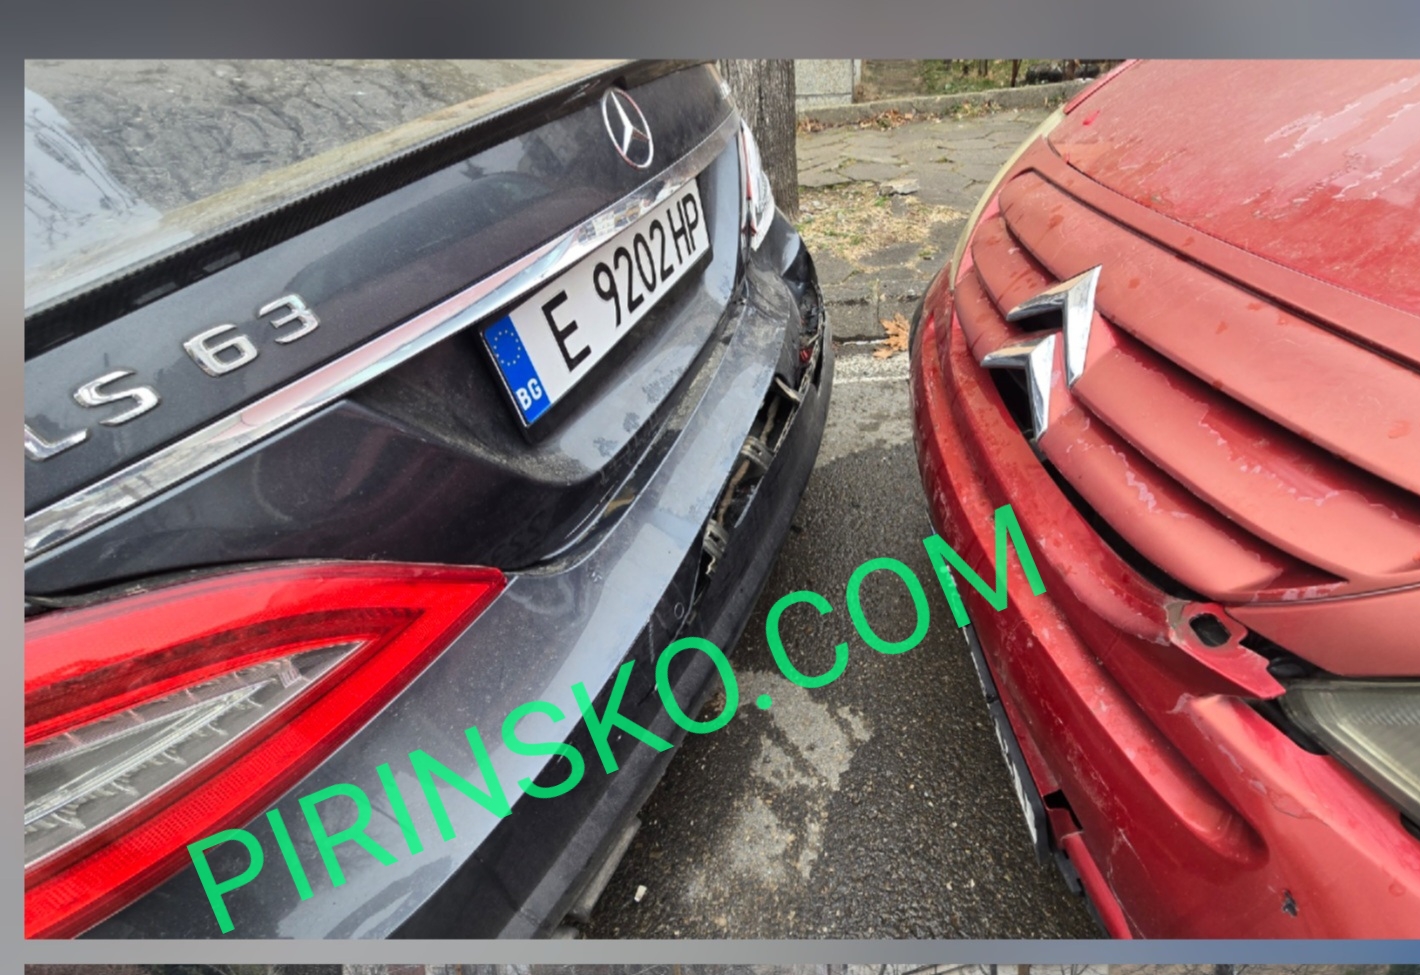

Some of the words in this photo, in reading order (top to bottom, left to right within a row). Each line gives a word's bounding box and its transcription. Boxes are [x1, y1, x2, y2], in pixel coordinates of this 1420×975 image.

[183, 294, 320, 378] 63
[541, 290, 592, 372] E
[516, 377, 543, 411] BG
